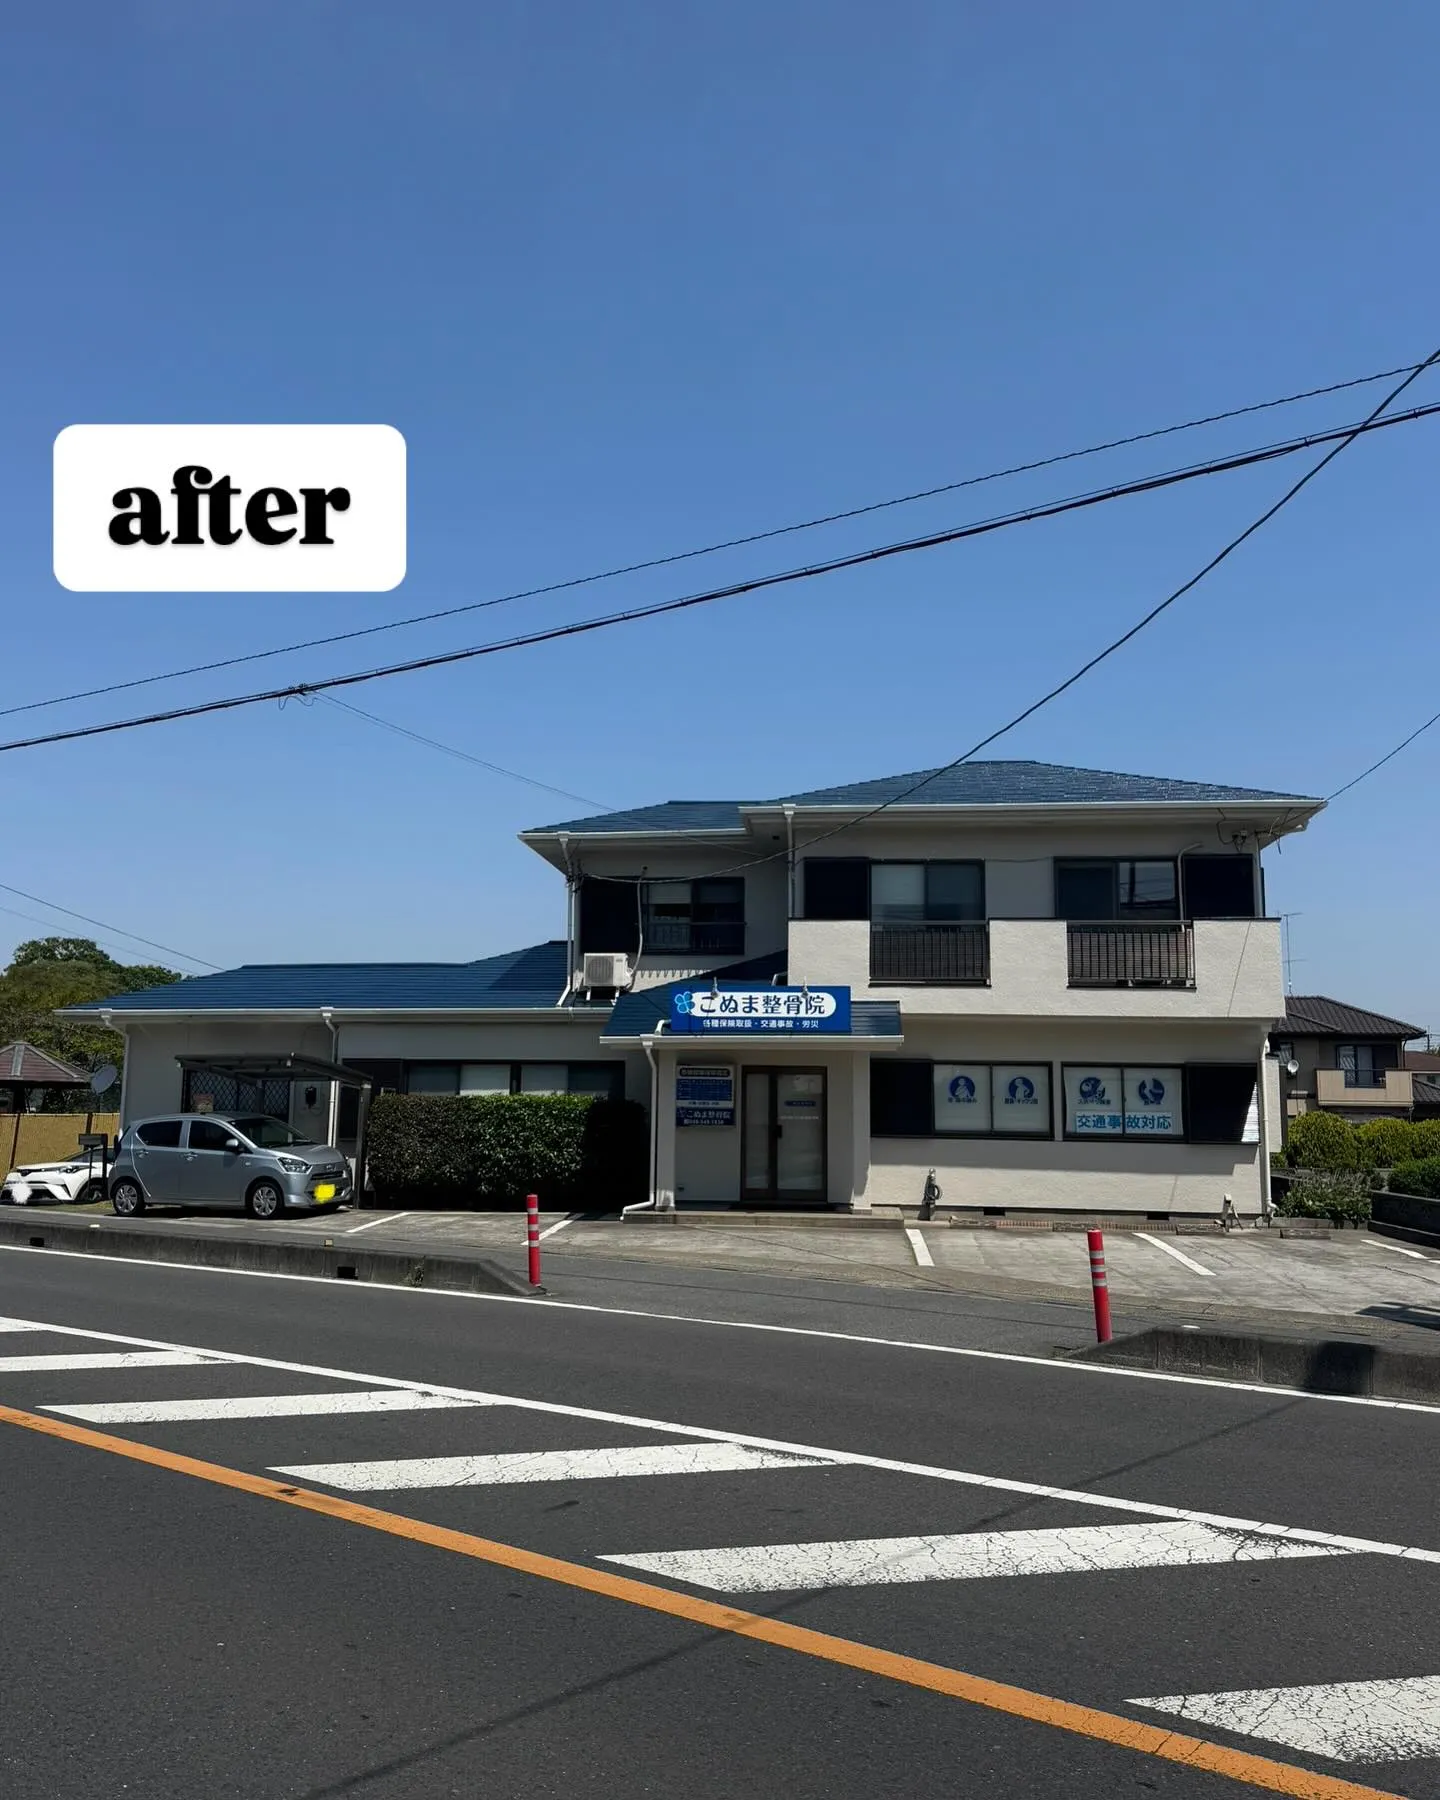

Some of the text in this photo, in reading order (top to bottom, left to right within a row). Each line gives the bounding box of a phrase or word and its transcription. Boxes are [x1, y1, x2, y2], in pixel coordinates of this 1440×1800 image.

[700, 994, 825, 1015] こぬま整骨院
[1077, 1115, 1171, 1129] 交通事故対応
